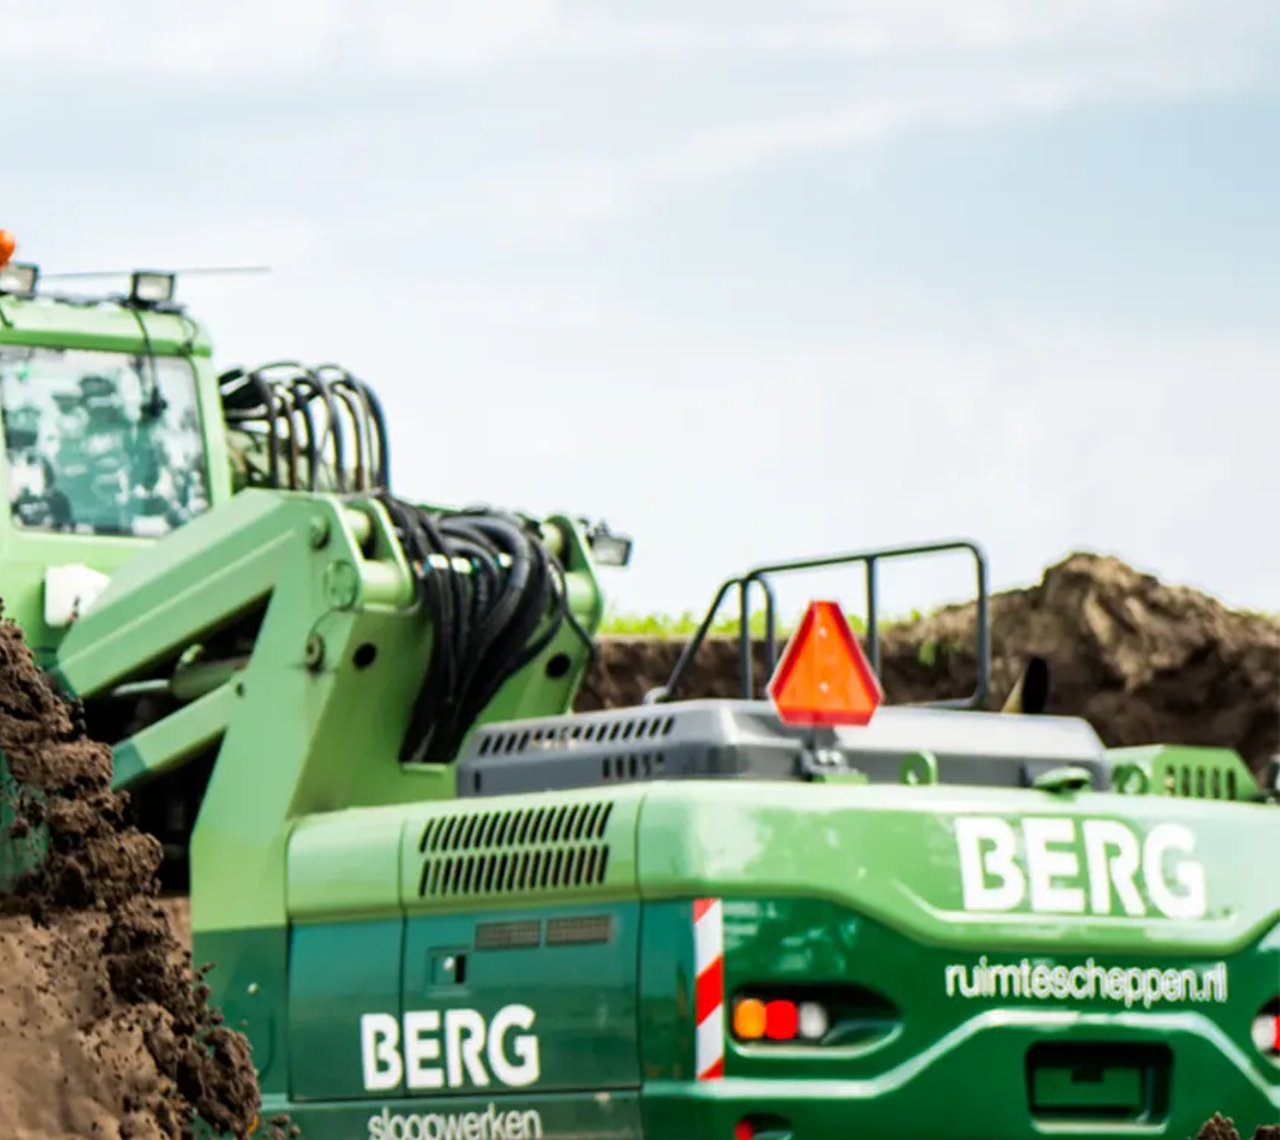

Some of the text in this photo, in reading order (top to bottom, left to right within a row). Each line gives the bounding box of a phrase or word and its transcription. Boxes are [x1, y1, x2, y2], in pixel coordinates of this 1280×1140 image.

[954, 817, 1207, 919] BERG
[945, 955, 1227, 1009] ruimtescheppen.nl
[360, 1003, 540, 1090] BERG
[368, 1102, 543, 1140] sloopwerken
